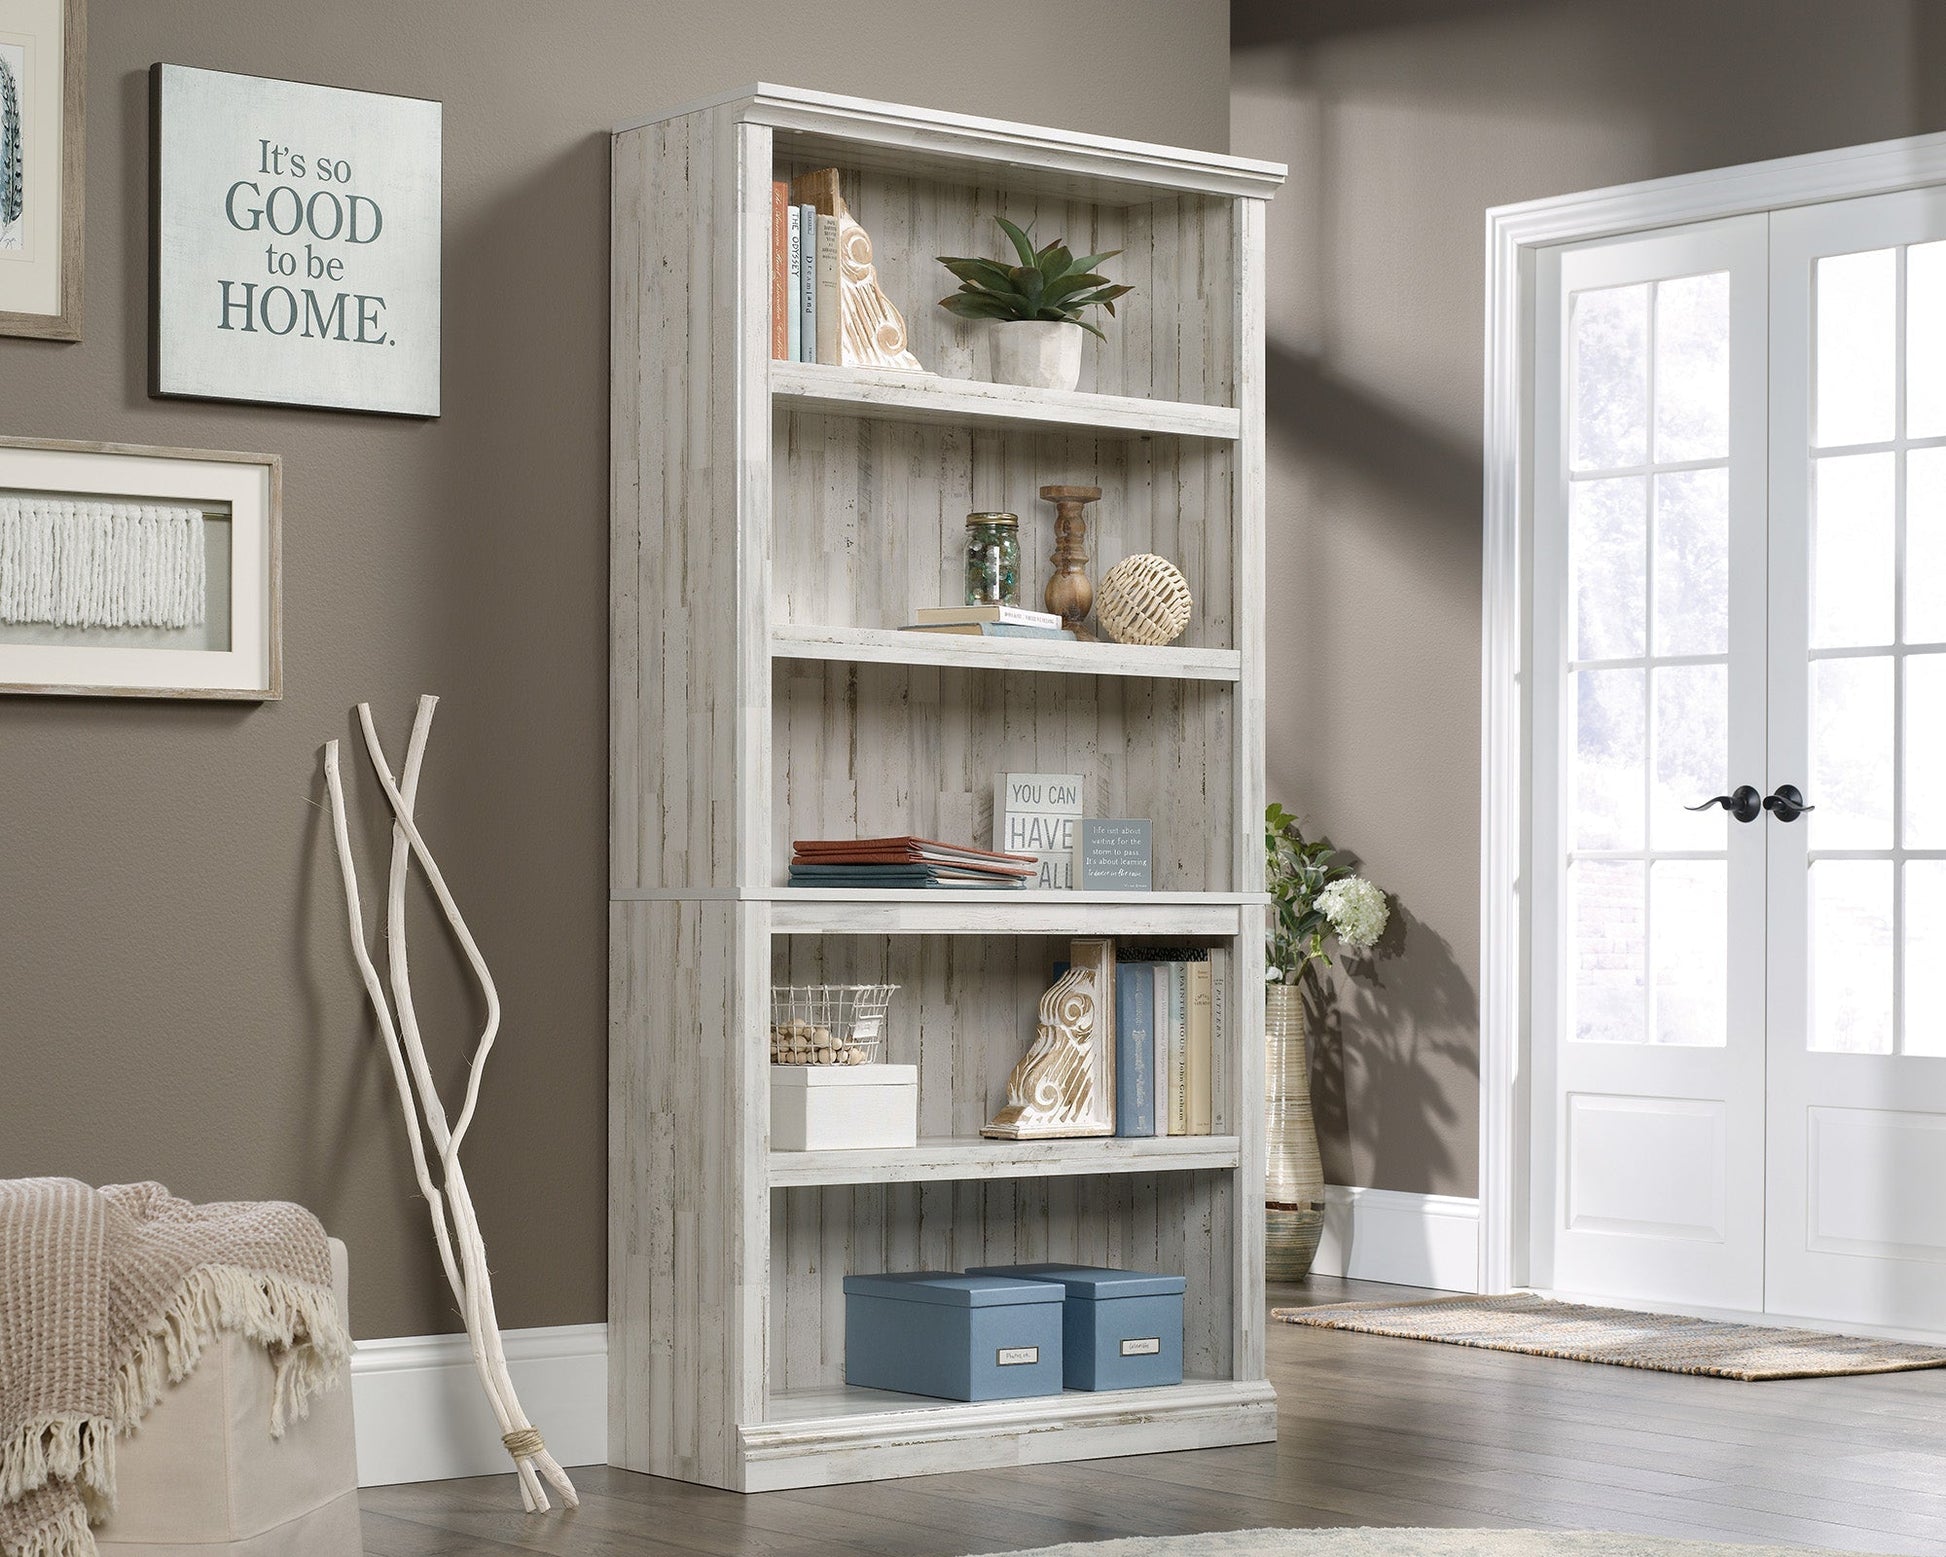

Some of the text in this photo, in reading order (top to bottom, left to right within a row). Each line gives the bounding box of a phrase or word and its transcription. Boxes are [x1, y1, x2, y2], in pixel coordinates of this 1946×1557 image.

[258, 138, 352, 185] It's so
[224, 180, 384, 245] GOOD
[265, 243, 345, 282] to be
[791, 213, 800, 277] THE ODYSSEY
[805, 255, 813, 314] Dreamland
[216, 280, 396, 347] HOME.
[1012, 784, 1077, 805] YOU CAN
[1010, 817, 1074, 850] HAVE
[1099, 857, 1118, 865] about
